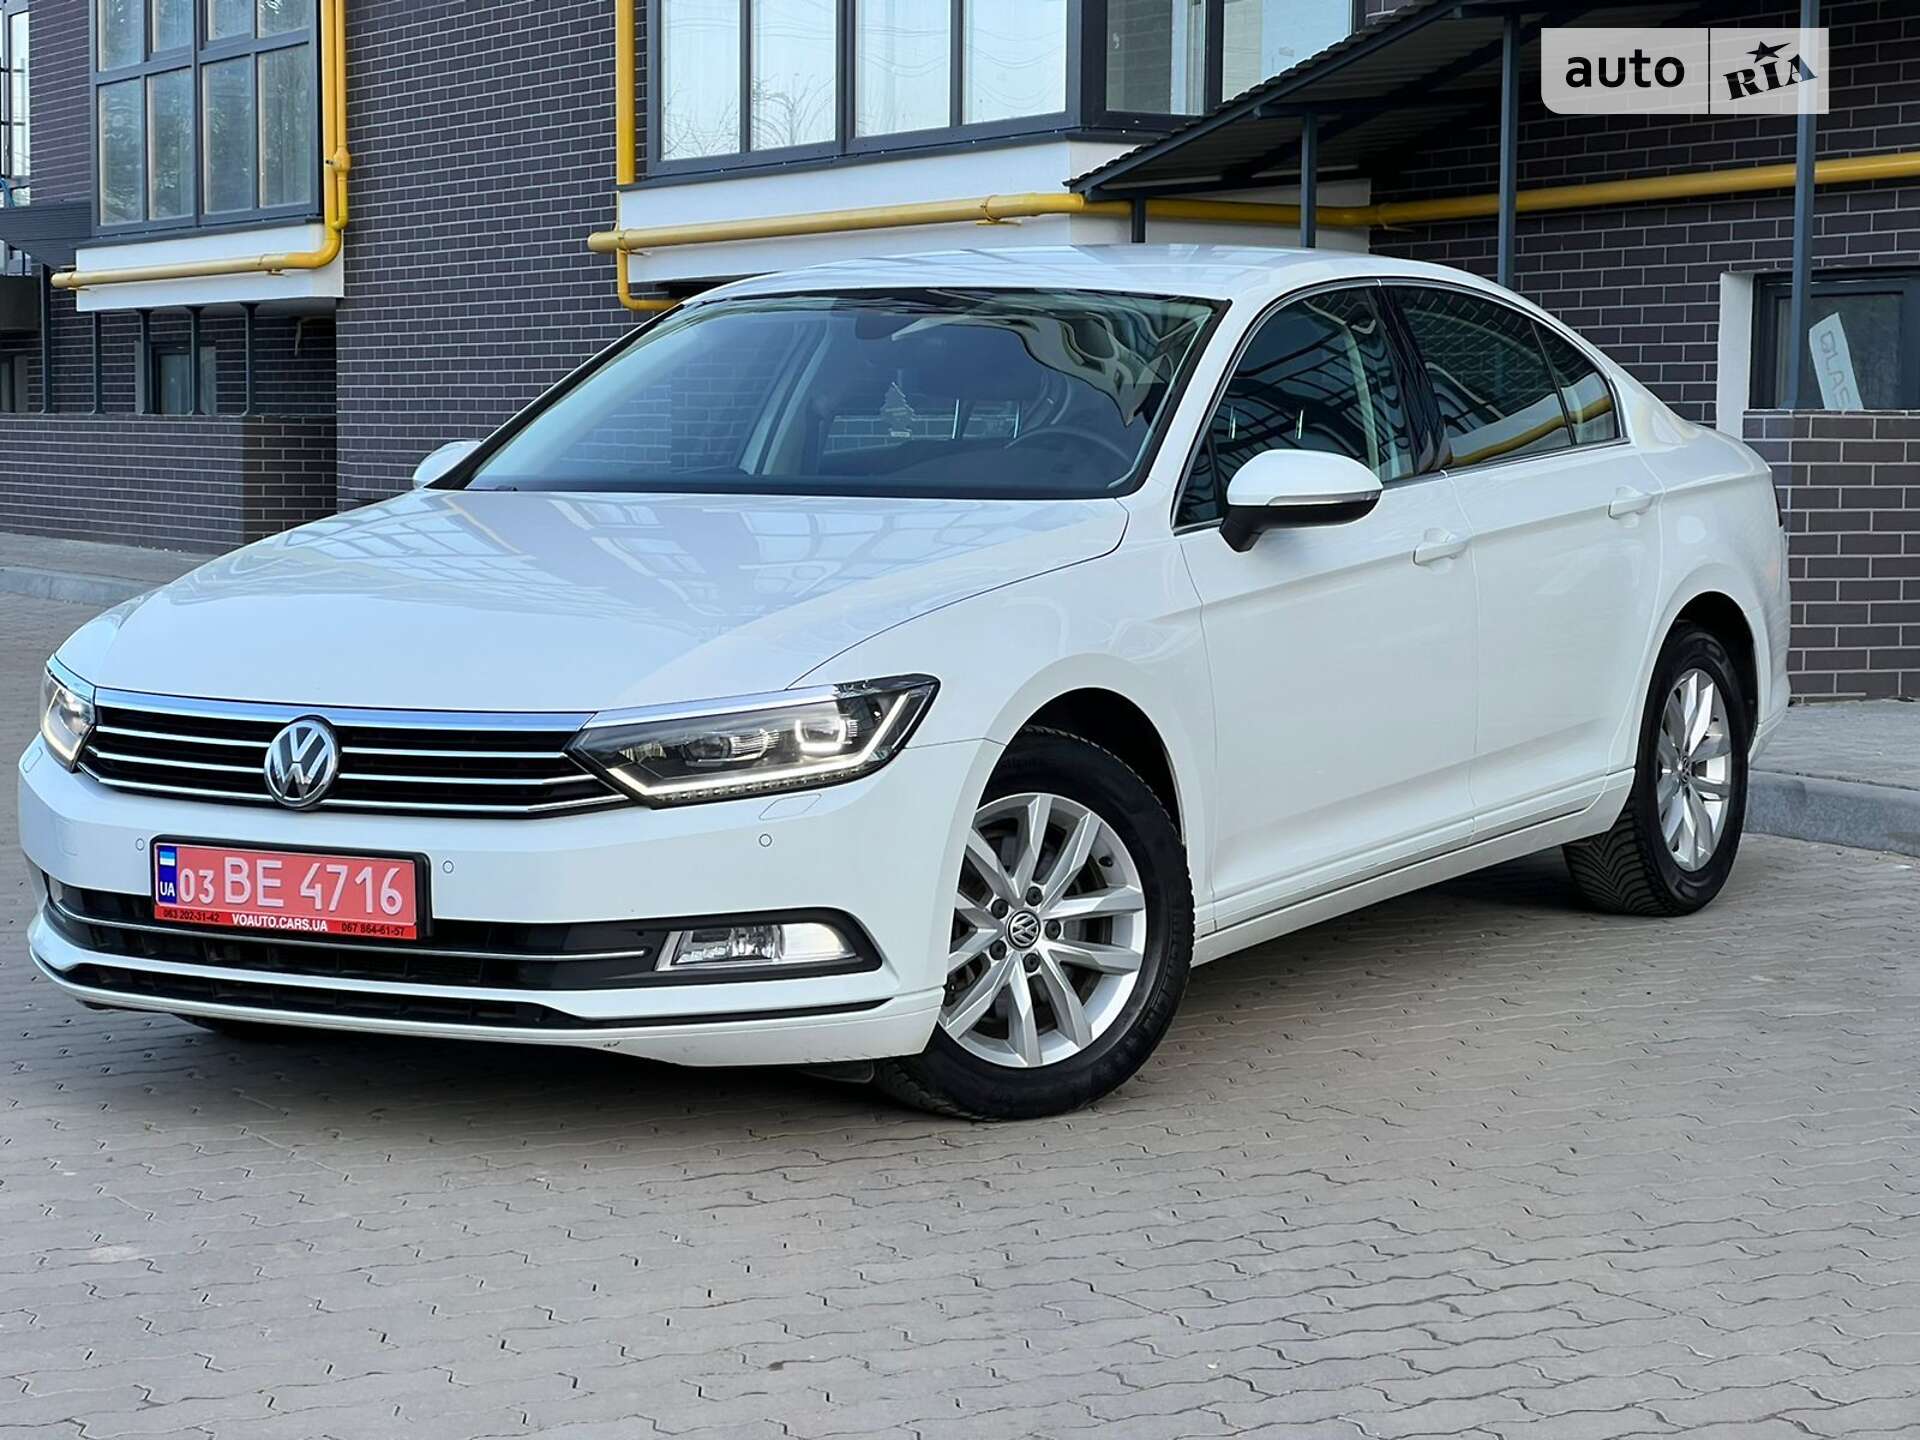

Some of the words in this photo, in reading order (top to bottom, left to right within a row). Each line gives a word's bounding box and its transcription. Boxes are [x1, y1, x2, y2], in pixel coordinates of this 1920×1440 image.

[159, 881, 176, 897] UA
[179, 868, 215, 904] 03
[223, 856, 285, 908] BE
[300, 862, 403, 915] 4716
[231, 913, 329, 932] VOAUTO.CARS.UA
